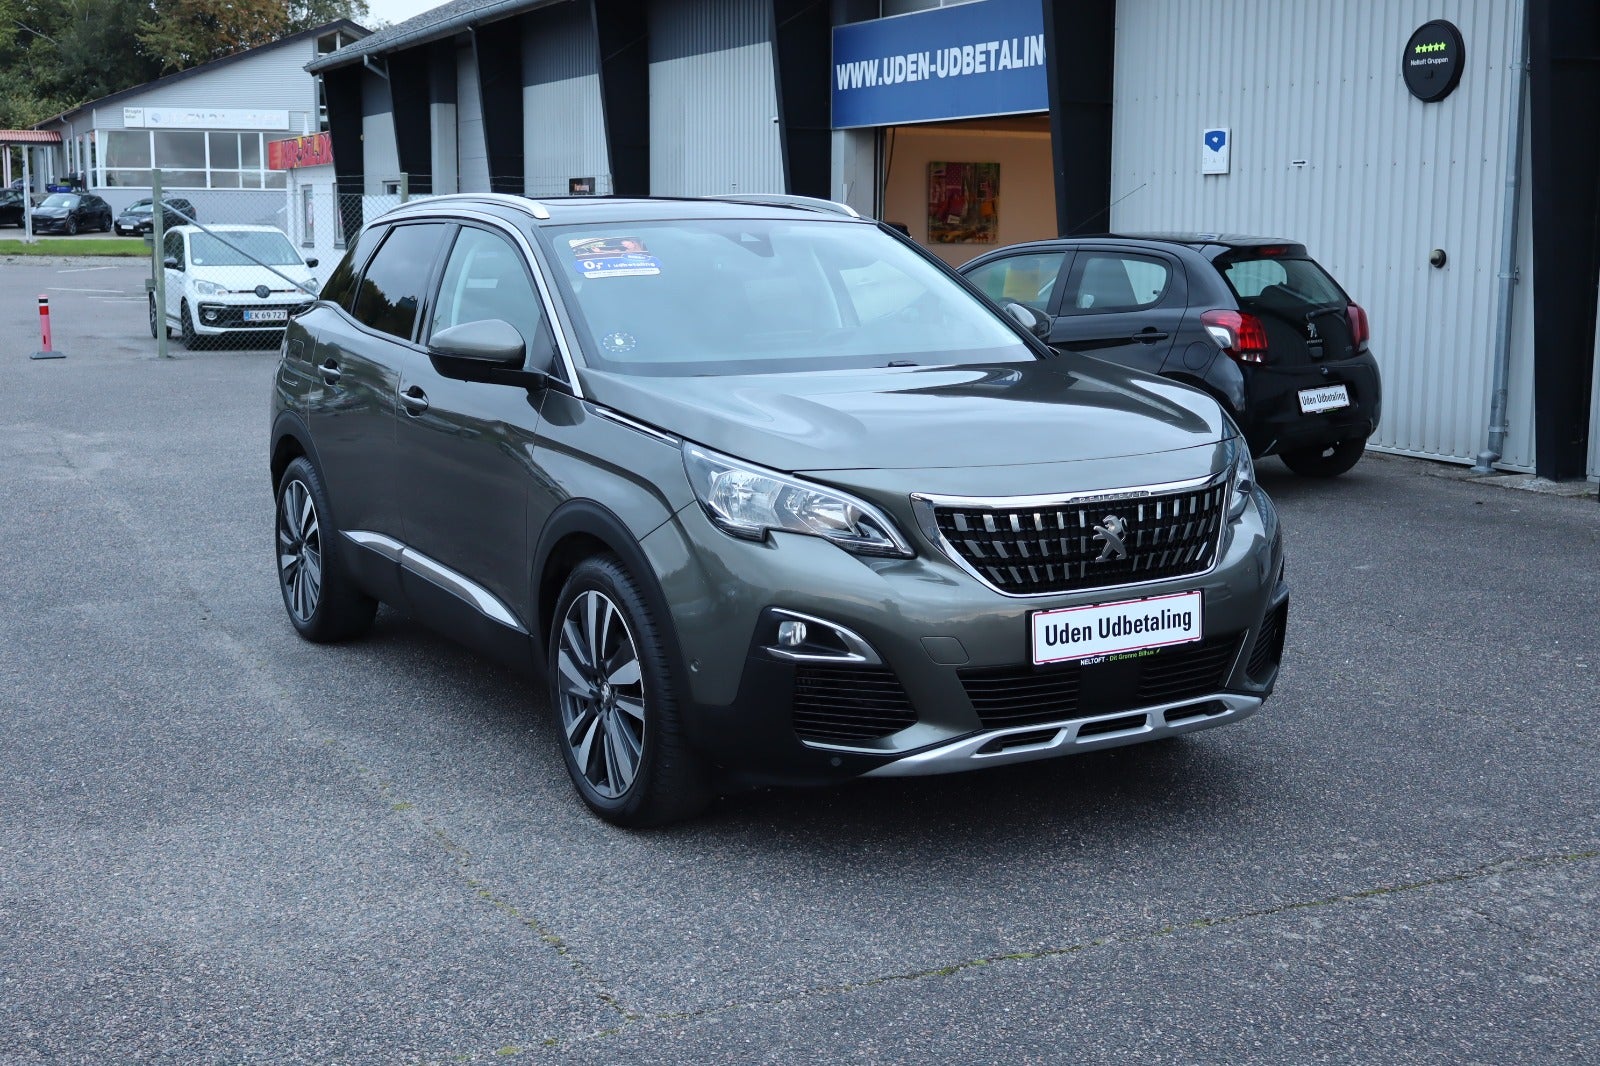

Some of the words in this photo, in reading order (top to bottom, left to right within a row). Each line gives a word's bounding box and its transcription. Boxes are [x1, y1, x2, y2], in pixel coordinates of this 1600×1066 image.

[836, 34, 1046, 90] WWW.UDEN-UDBETALIN
[1427, 57, 1449, 65] Gruppen
[250, 311, 259, 319] EK
[261, 311, 271, 319] 69
[272, 311, 286, 319] 727
[1301, 395, 1316, 405] Uden
[1317, 392, 1346, 403] Udbetaling
[1045, 623, 1092, 647] Uden
[1098, 609, 1192, 639] Udbetaling
[1080, 656, 1106, 666] NELTOFT
